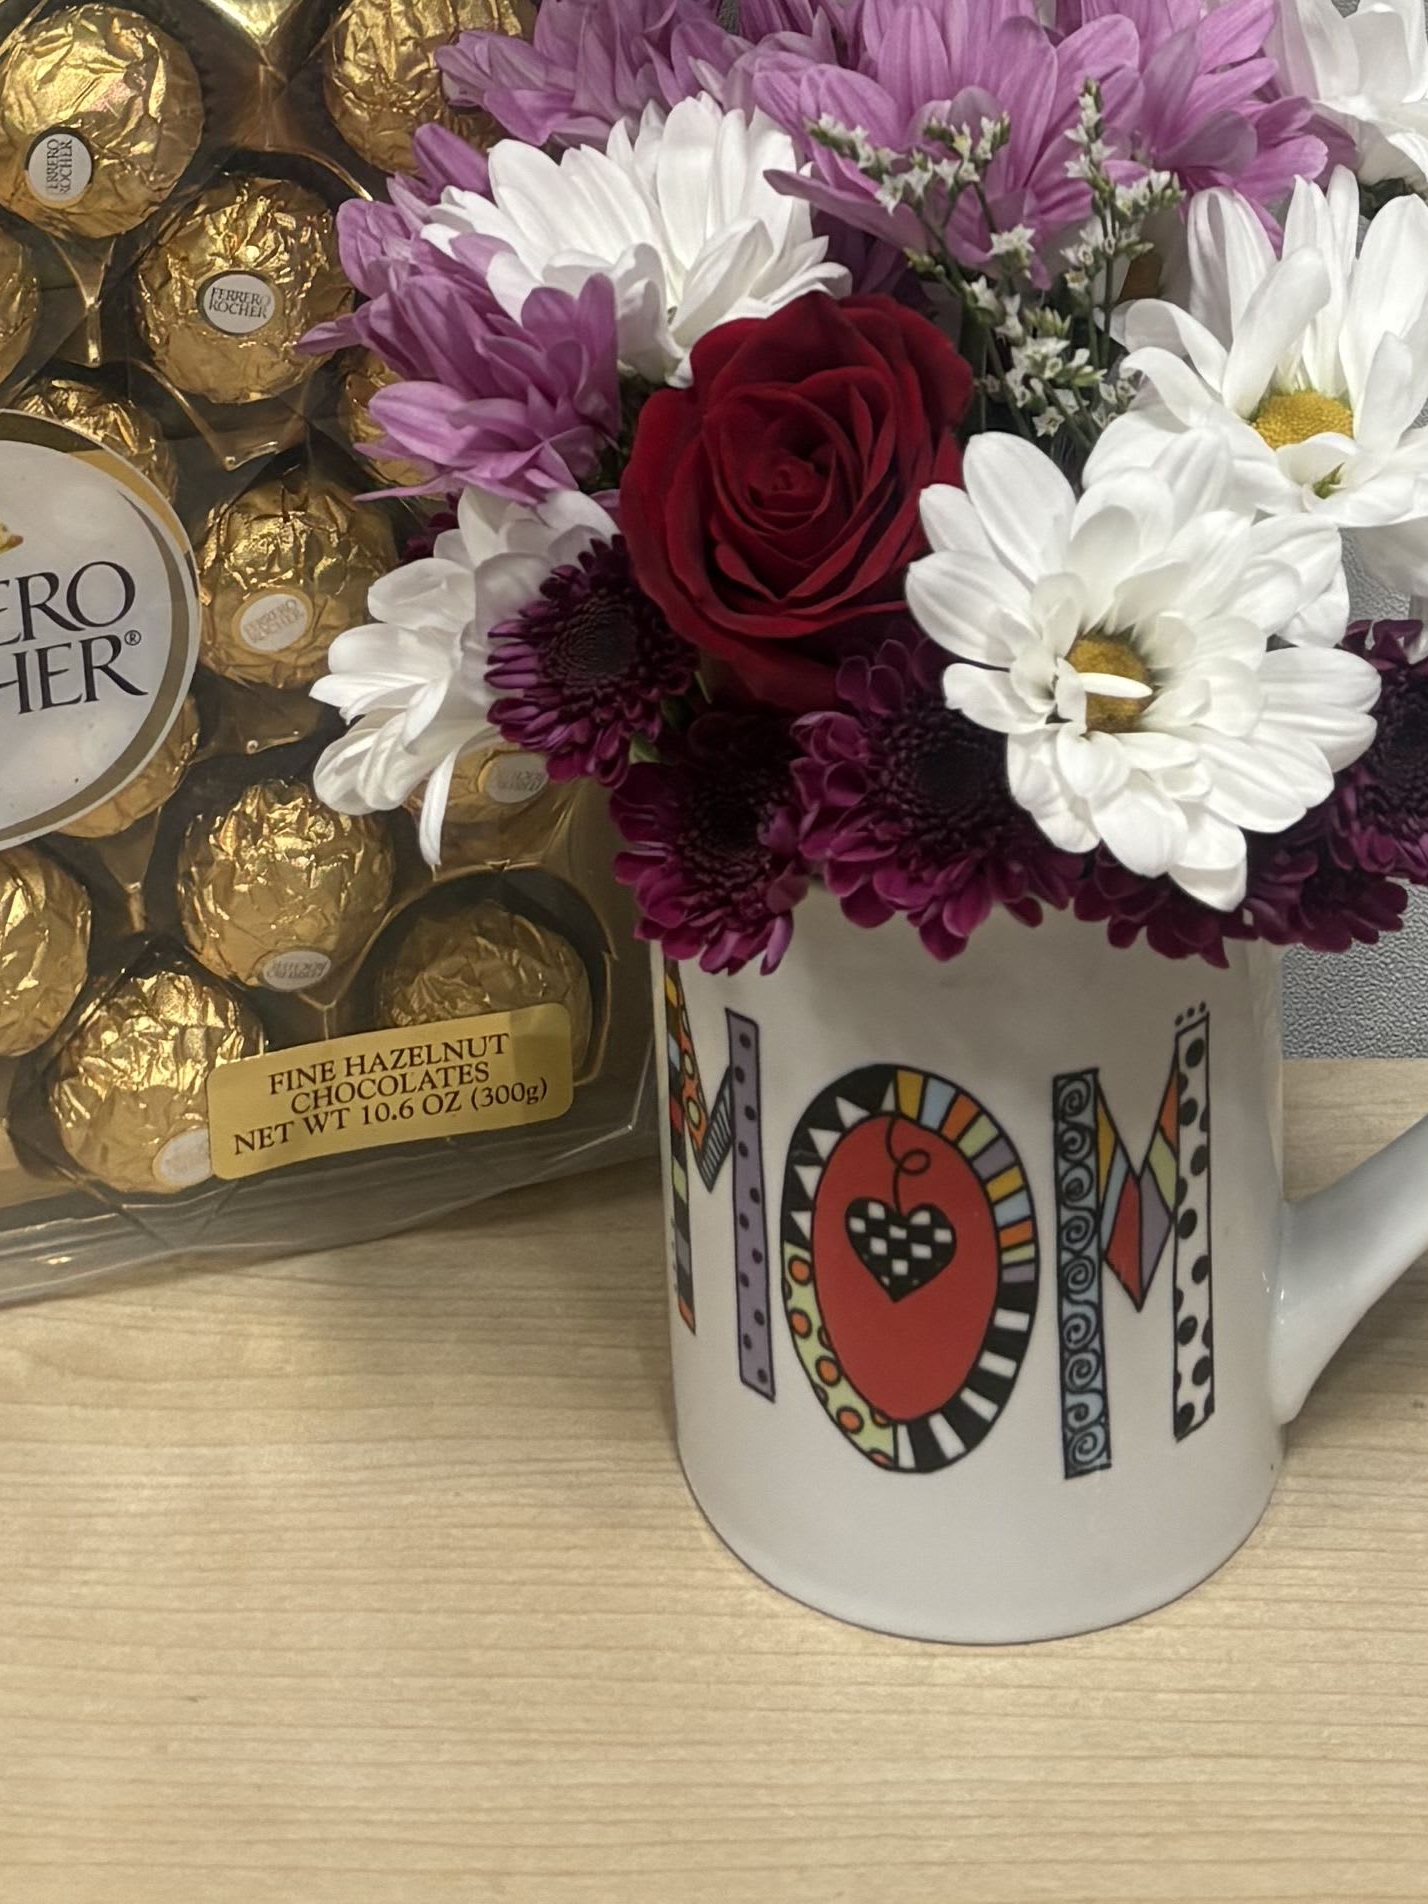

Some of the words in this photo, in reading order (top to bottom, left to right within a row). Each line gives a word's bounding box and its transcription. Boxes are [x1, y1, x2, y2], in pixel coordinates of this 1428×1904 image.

[209, 298, 268, 319] ROCHER
[210, 286, 271, 306] FERRERO
[268, 1059, 336, 1095] FINE
[344, 1033, 510, 1079] HAZELNUT
[291, 1062, 490, 1114] CHOCOLATES
[234, 1121, 296, 1156] NET
[302, 1108, 351, 1137] WT
[362, 1097, 415, 1126] 10.6
[422, 1090, 462, 1117] OZ
[470, 1077, 548, 1111] (300g)
